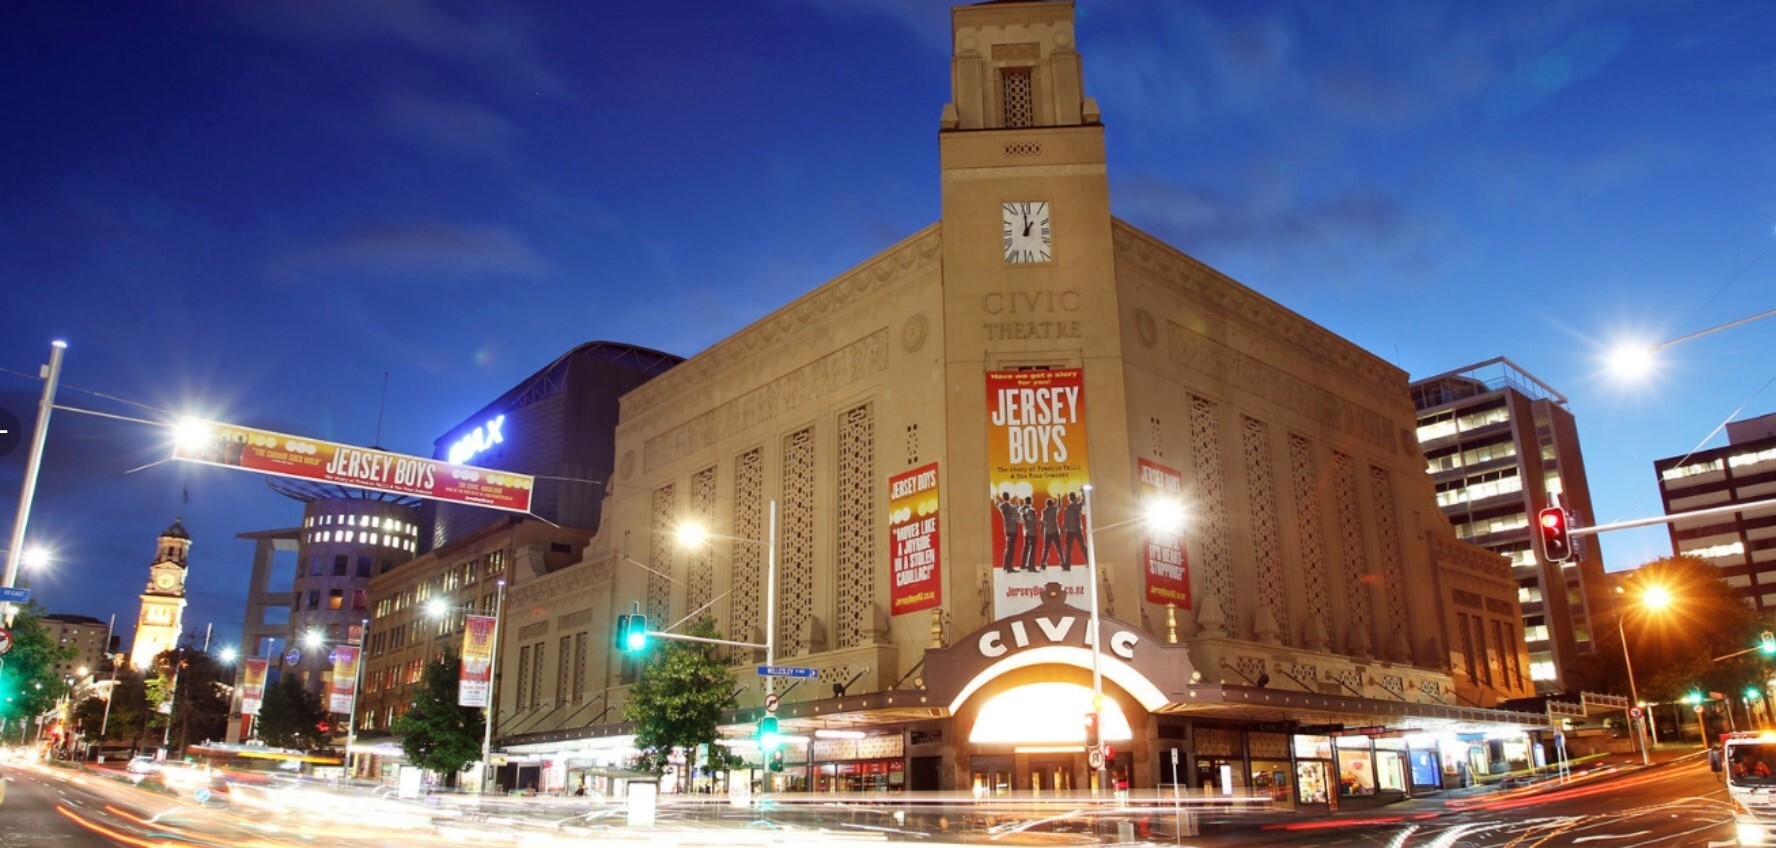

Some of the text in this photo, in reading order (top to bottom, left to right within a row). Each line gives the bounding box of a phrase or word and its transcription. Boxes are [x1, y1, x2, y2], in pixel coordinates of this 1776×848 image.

[982, 290, 1081, 315] CIVIC
[983, 321, 1083, 341] THEATRE
[1030, 371, 1045, 380] got
[1054, 371, 1078, 379] story
[992, 386, 1079, 426] JERSEY
[1008, 425, 1068, 464] BOYS
[325, 447, 436, 489] JERSEY BOYS
[891, 469, 936, 500] JERSEY BOYS
[921, 517, 936, 535] LIKE
[897, 541, 903, 557] A
